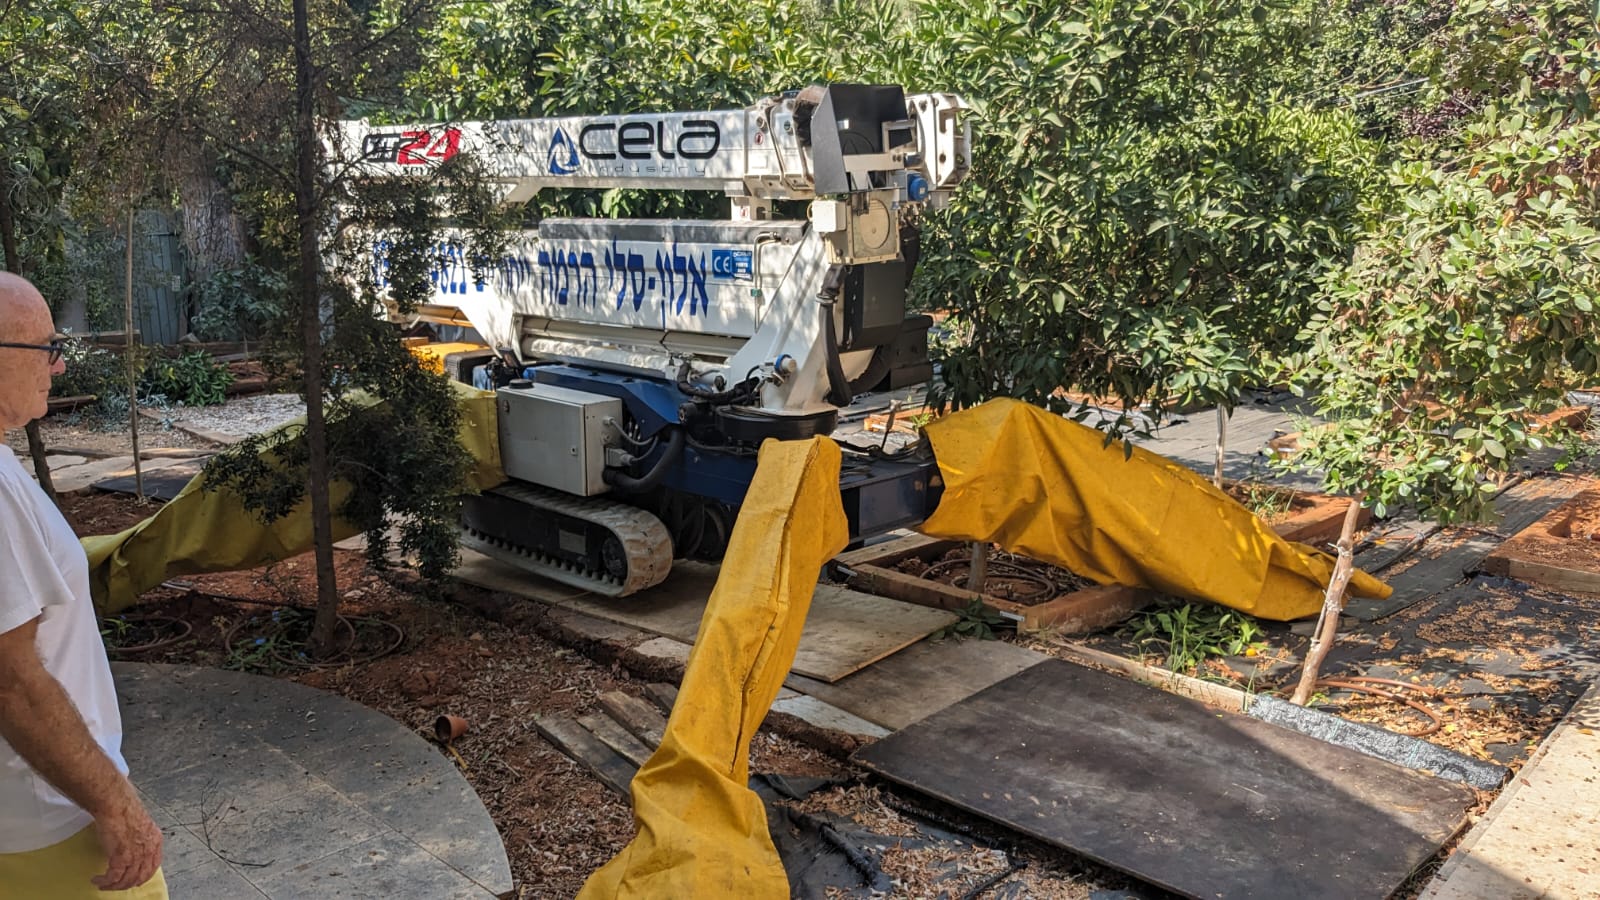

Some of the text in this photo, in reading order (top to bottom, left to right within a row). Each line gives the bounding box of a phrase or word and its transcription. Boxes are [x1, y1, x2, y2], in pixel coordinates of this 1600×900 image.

[578, 120, 721, 160] cela
[590, 163, 706, 177] ndustry
[537, 247, 597, 309] הרמה
[605, 235, 709, 330] אלון-סלי
